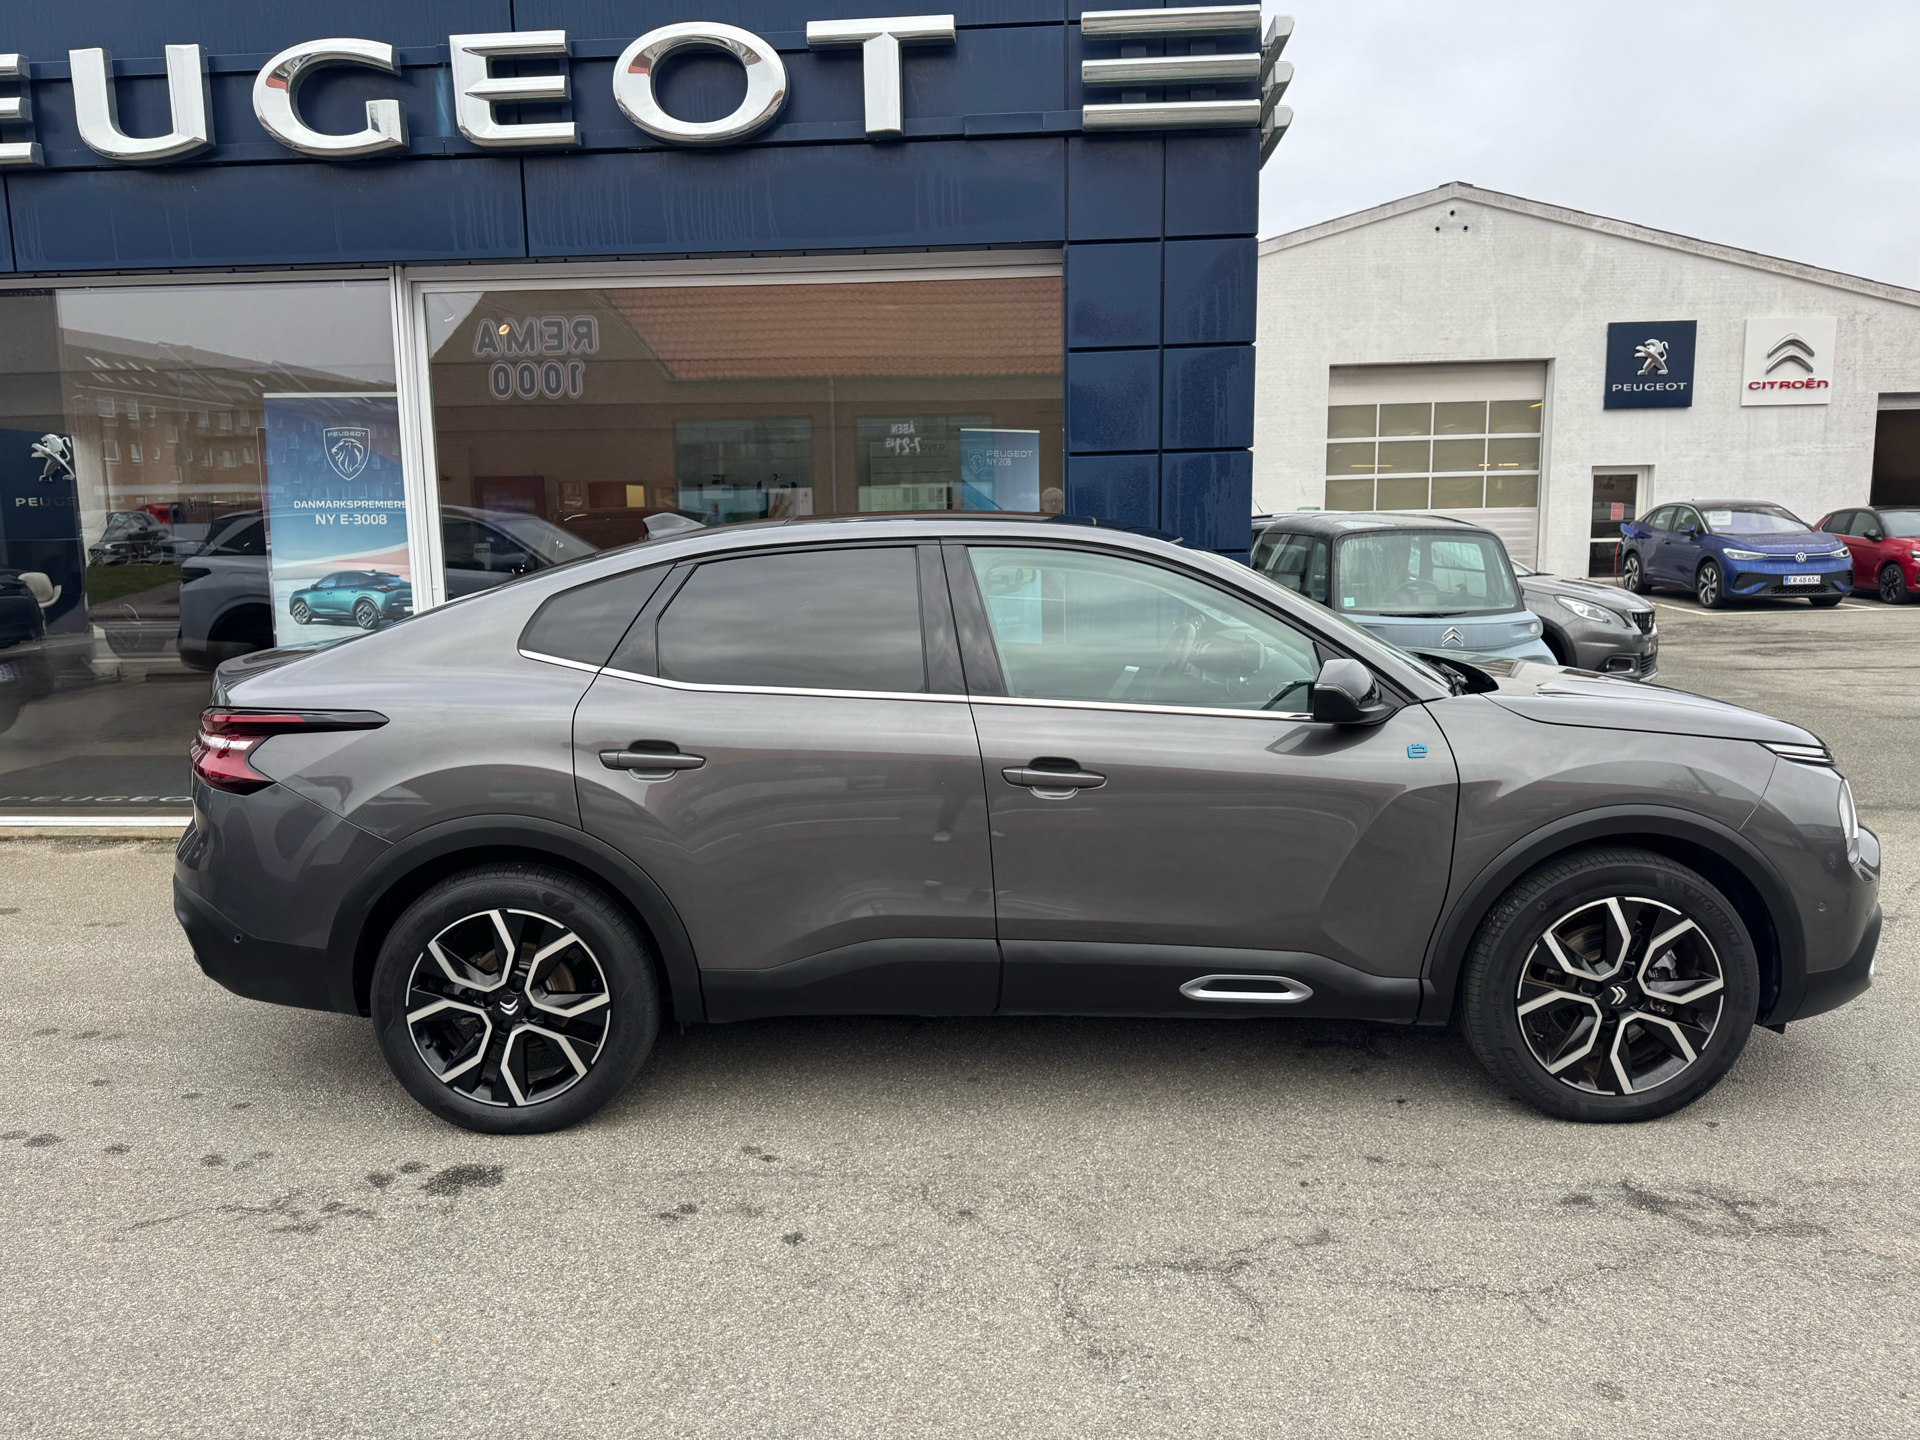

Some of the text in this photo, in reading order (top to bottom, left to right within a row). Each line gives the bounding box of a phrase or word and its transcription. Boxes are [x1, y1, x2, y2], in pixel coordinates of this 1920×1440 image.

[1612, 382, 1687, 392] PEUGEOT
[986, 450, 1033, 458] PEUGEOT
[293, 500, 406, 509] DANMARKSPREMIERE
[315, 514, 387, 524] NY E-3008
[1686, 888, 1740, 945] MICHELIN
[1503, 1049, 1559, 1103] MICHELIN
